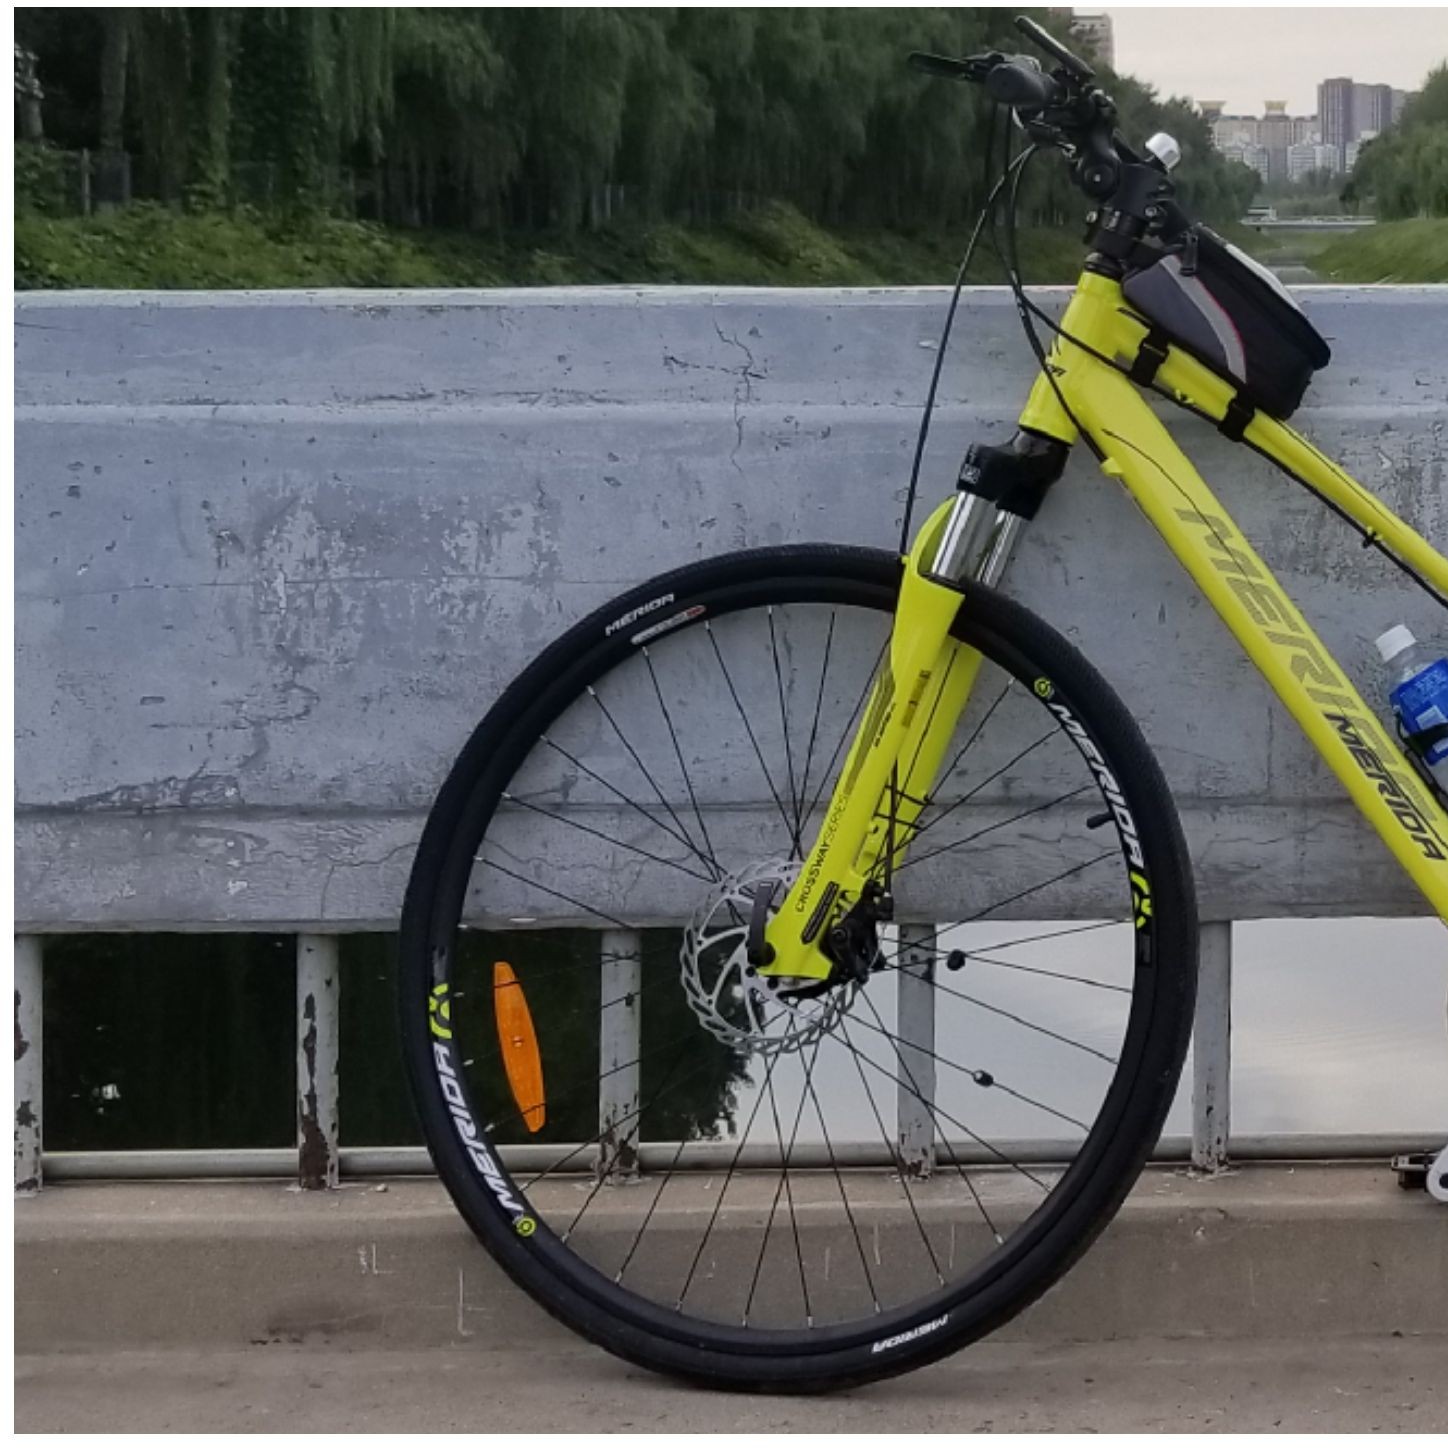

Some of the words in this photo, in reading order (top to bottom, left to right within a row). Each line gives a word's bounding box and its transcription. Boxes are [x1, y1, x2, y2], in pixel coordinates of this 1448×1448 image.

[604, 592, 675, 637] MERIDA
[1048, 702, 1145, 870] MERIDA
[1323, 711, 1447, 862] MERIDA
[433, 1041, 525, 1219] MERIDA
[871, 1313, 949, 1354] MERIDA
